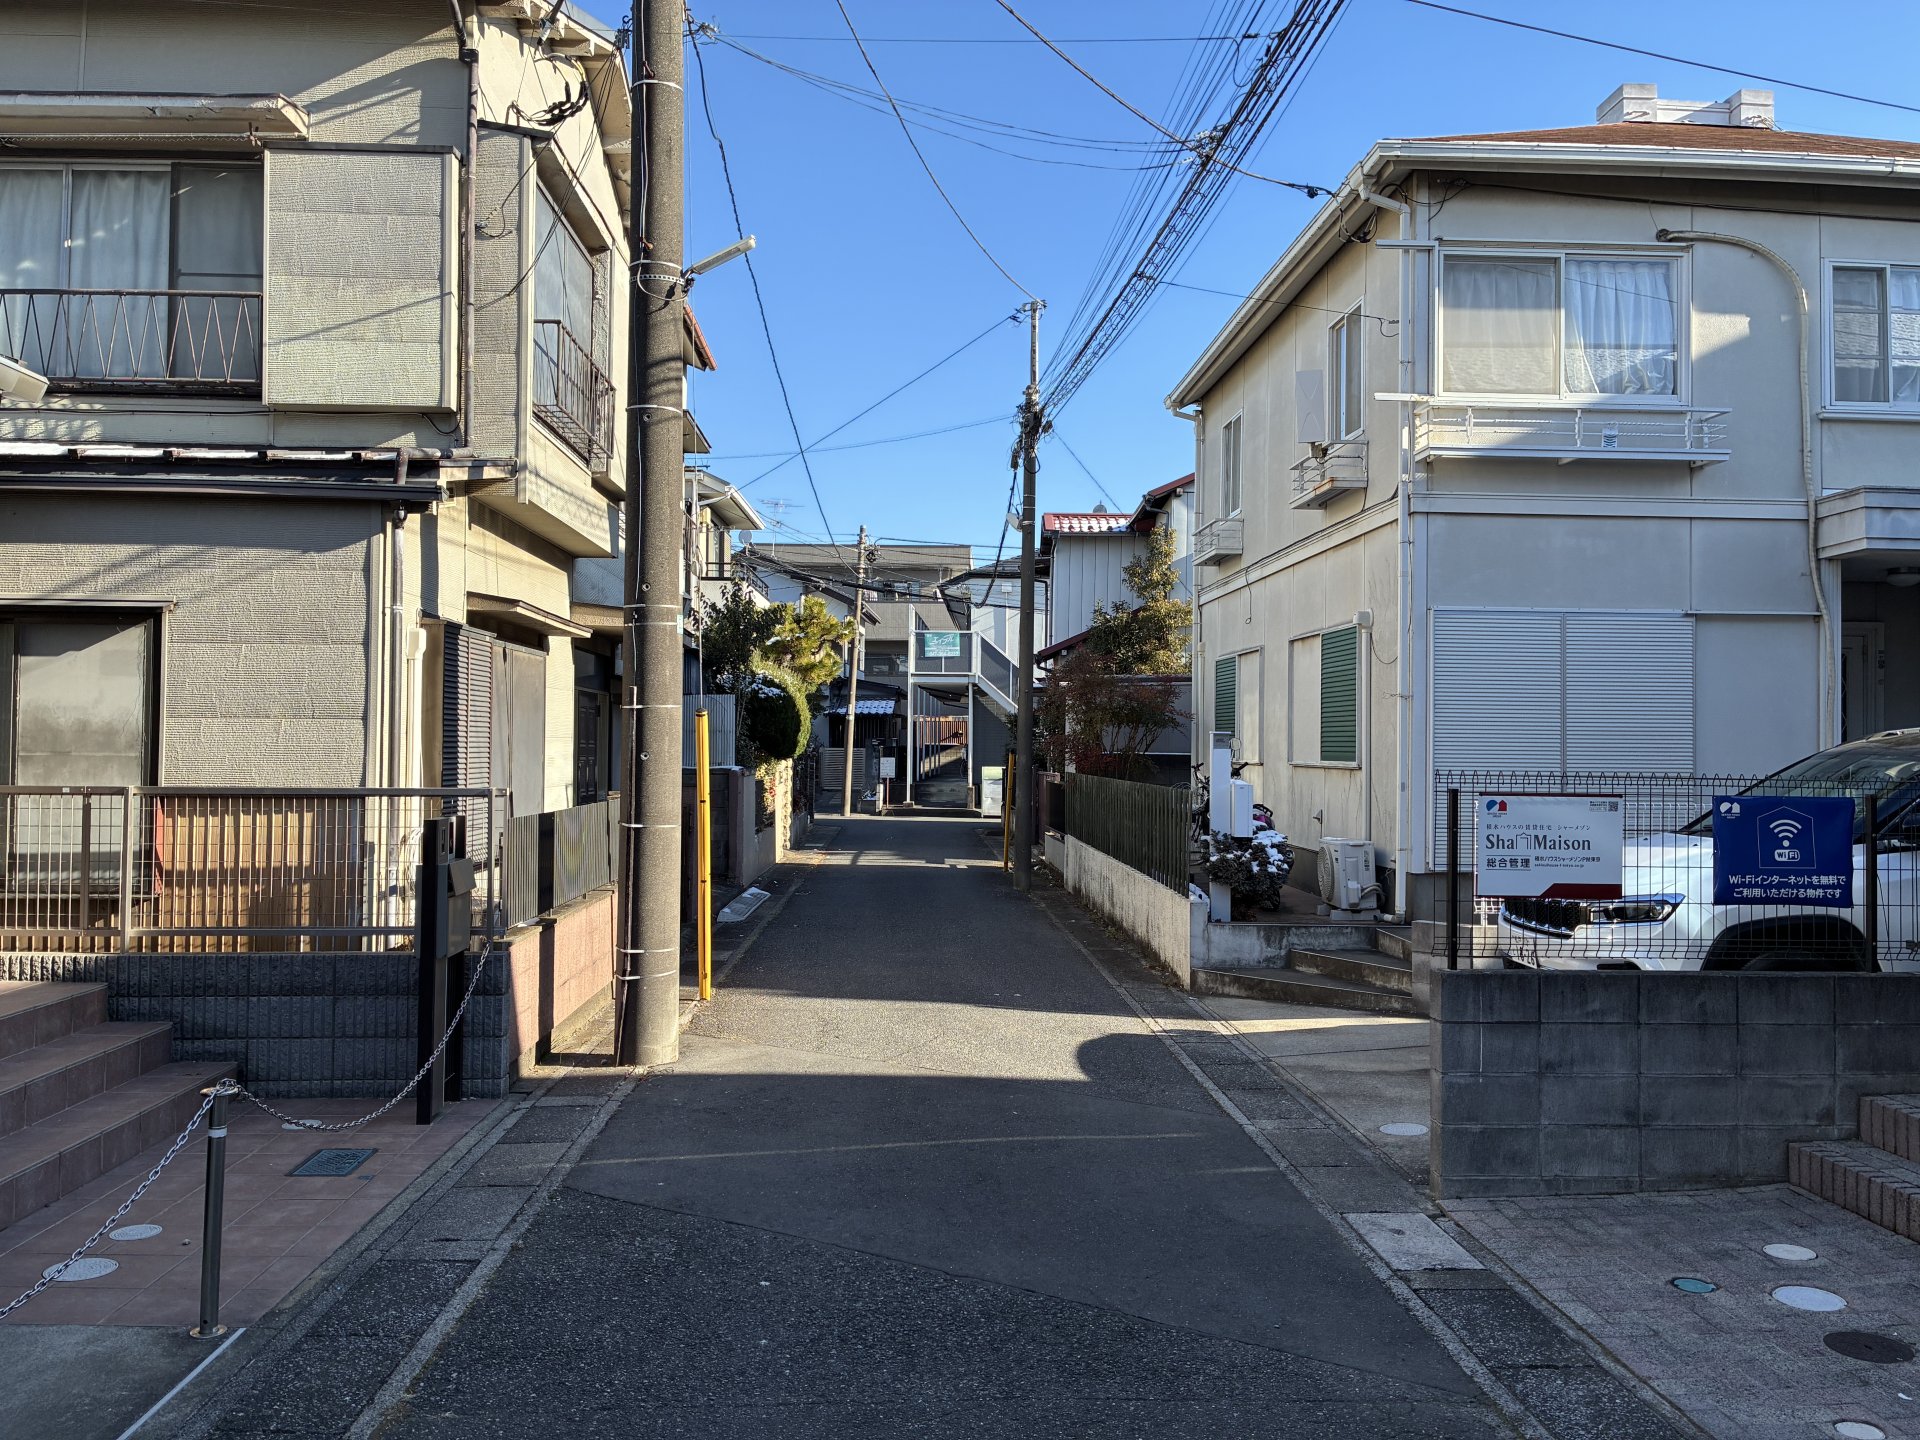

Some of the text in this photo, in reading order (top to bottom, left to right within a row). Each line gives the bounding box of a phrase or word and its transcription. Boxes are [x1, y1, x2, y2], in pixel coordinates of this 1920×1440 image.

[1486, 834, 1591, 851] Sha Maison
[1487, 858, 1530, 868] 総合管理
[1729, 875, 1847, 885] Wi-Fiインターネットを無料で
[1733, 888, 1842, 898] ご利用いただける物件です
